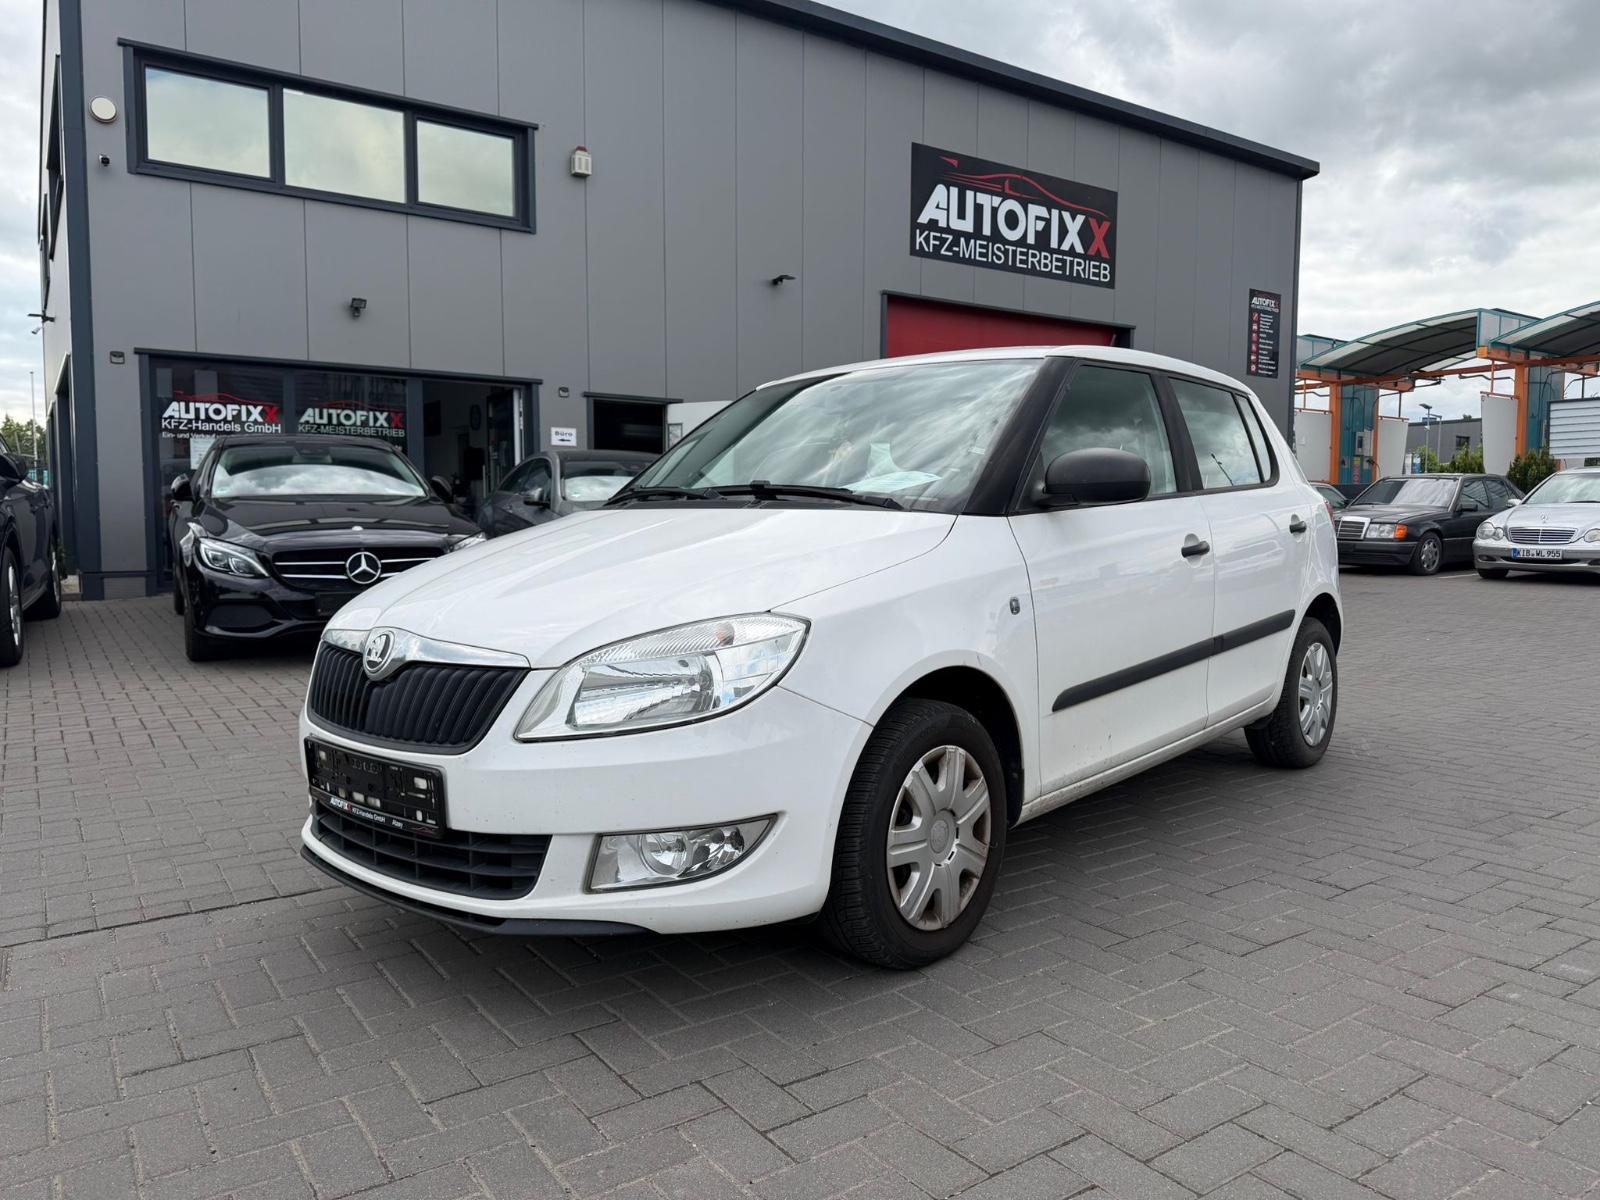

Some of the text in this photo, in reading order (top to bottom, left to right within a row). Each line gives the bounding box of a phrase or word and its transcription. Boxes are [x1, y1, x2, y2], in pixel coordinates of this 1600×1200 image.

[917, 184, 1111, 259] AUTOFIXX
[916, 229, 1110, 282] KFZ-MEISTERBETRIEB
[162, 401, 279, 423] AUTOFIXX
[299, 408, 404, 429] AUTOFIXX
[162, 419, 281, 433] KFZ-Handels GmbH
[298, 424, 405, 437] KFZ-MEISTERBETRIEB
